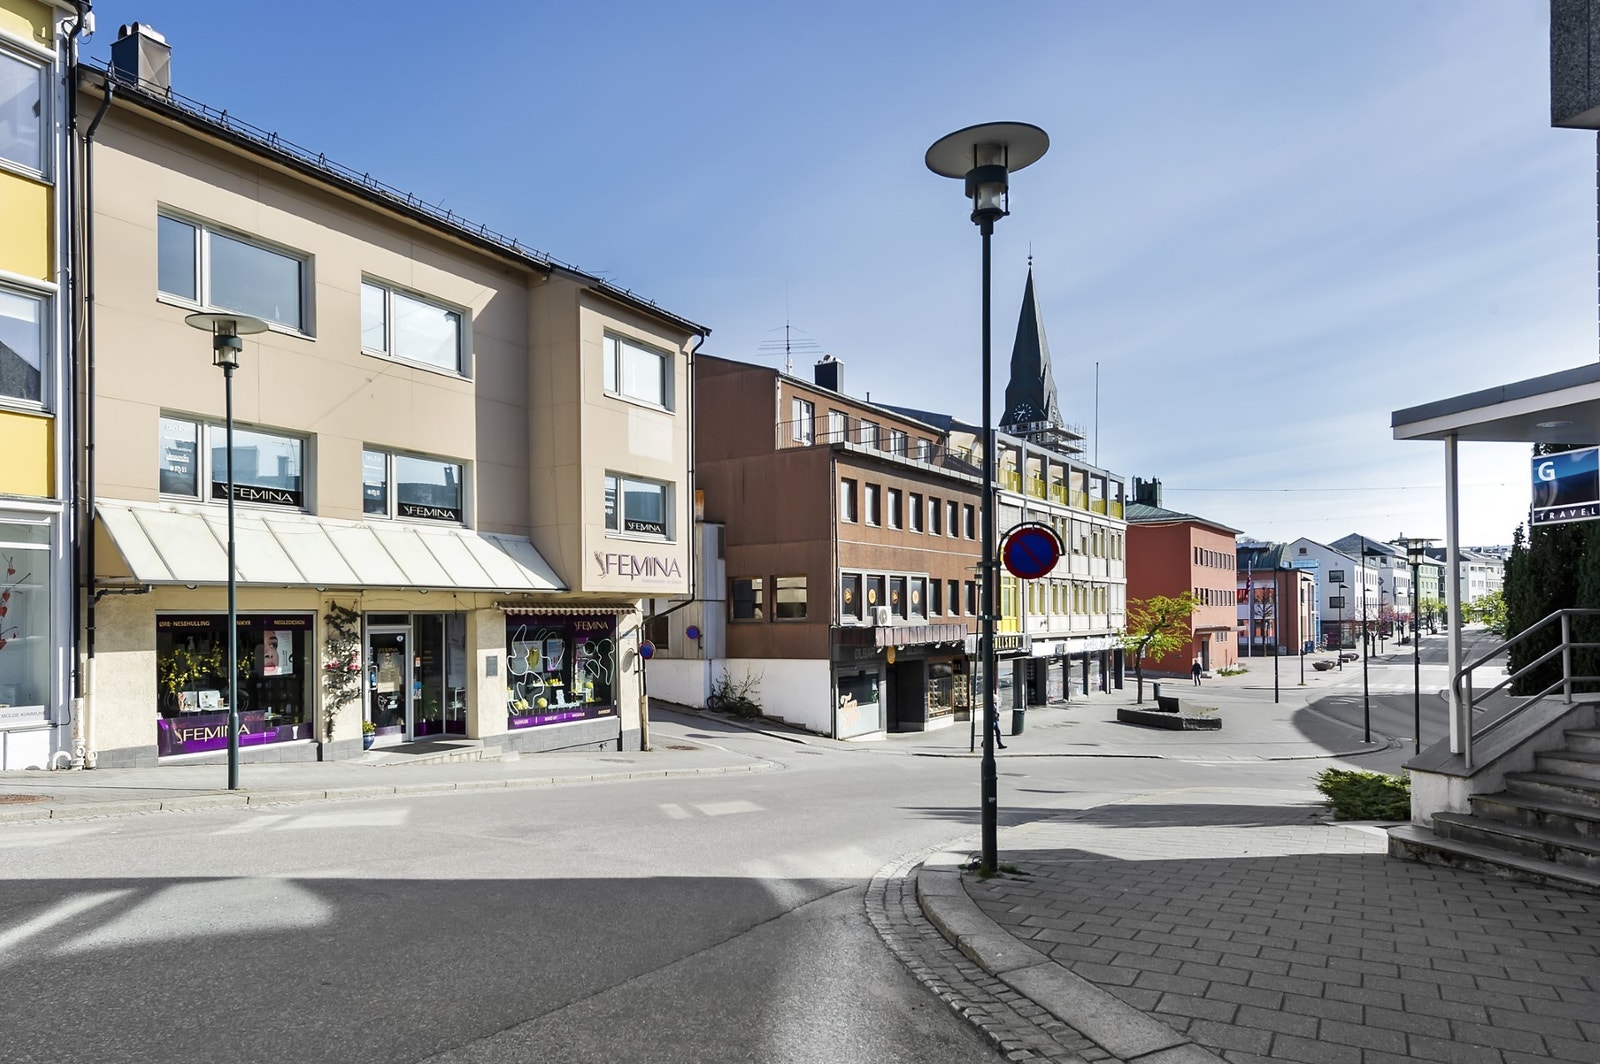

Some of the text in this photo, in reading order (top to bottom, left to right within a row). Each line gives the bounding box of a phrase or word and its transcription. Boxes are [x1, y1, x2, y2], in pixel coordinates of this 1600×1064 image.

[1538, 461, 1556, 481] G
[409, 505, 455, 519] FEMINA
[1540, 507, 1596, 520] TRAVEL
[631, 522, 661, 532] FEMINA
[605, 553, 682, 581] FEMINA
[577, 621, 609, 631] FEMINA
